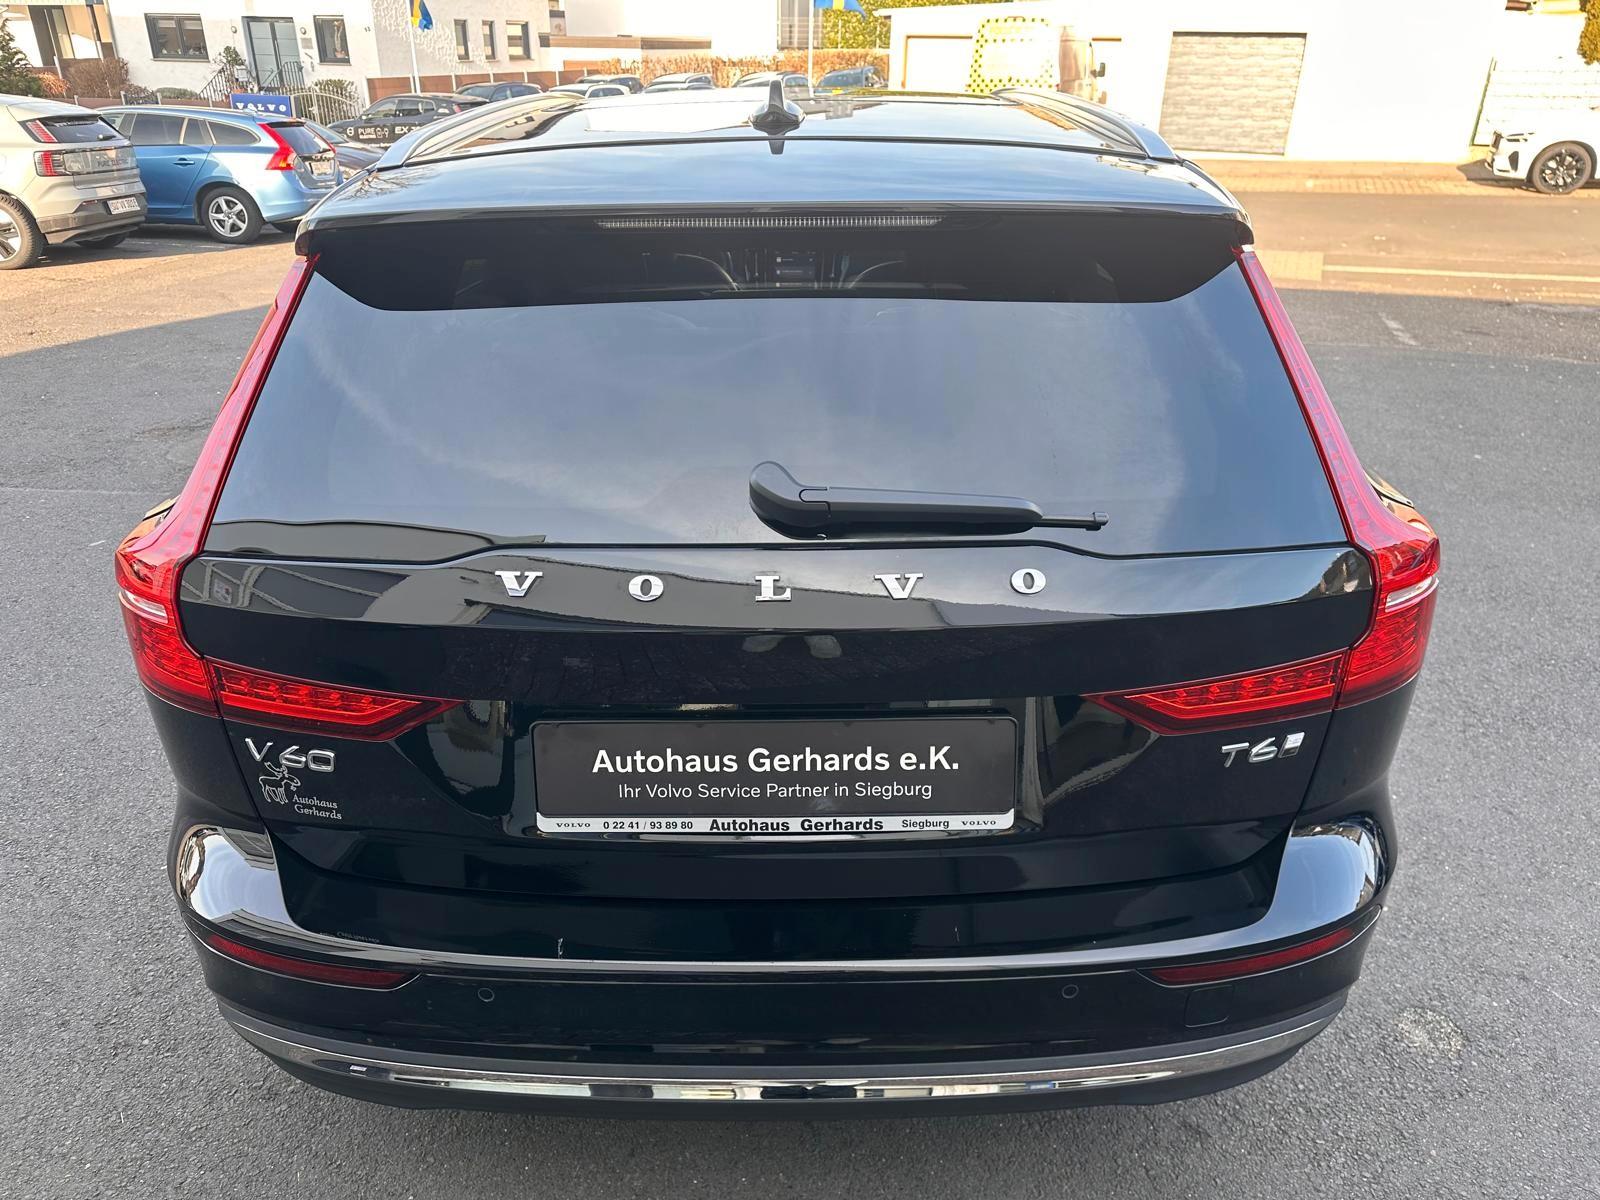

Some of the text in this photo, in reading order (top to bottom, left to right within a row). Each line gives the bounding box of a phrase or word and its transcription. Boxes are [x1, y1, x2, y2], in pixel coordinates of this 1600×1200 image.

[235, 102, 287, 112] VOLVO
[494, 568, 1048, 604] VOLVO
[245, 737, 336, 772] V60
[592, 745, 960, 773] Autohaus Gerhards e.K.
[1221, 736, 1279, 768] T6
[618, 781, 932, 799] Ihr Volvo Service Partner in Siegburg
[292, 794, 338, 809] Autohaus
[294, 804, 342, 820] Gerhards
[603, 821, 610, 829] 0
[612, 821, 625, 829] 22
[627, 821, 640, 829] 41
[649, 821, 662, 829] 93
[665, 821, 678, 829] 89
[680, 821, 693, 829] 80
[709, 818, 884, 832] Autohaus Gerhards
[901, 819, 950, 829] Siegburg
